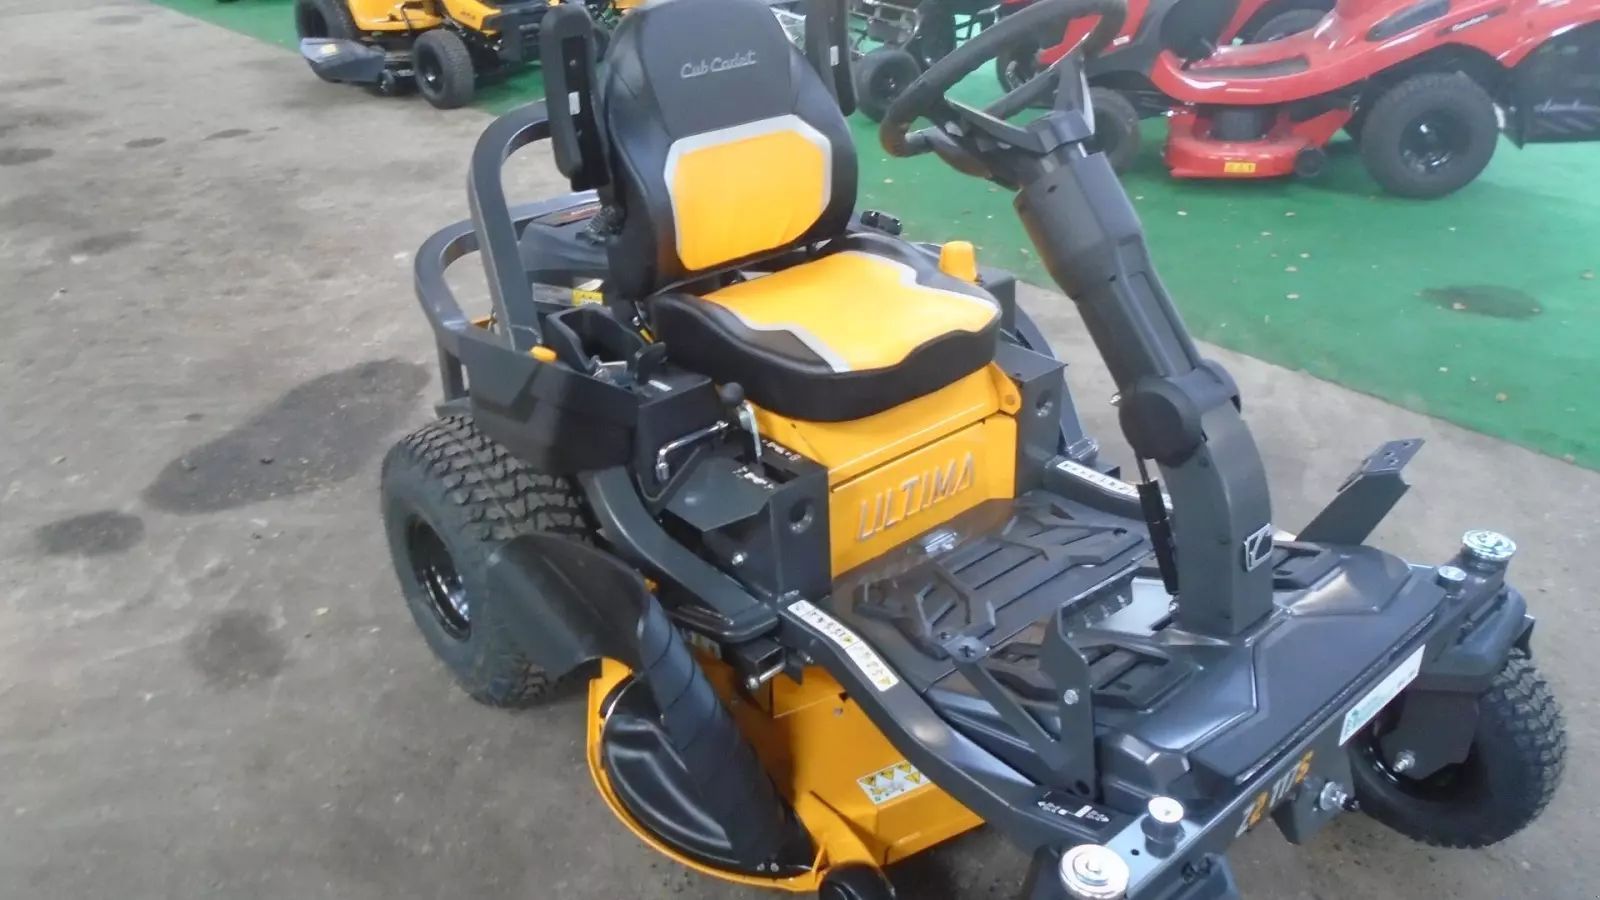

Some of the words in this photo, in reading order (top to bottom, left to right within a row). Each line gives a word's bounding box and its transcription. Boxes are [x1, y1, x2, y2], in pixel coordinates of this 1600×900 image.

[681, 60, 708, 78] Cub
[711, 51, 757, 72] Cadet
[858, 453, 974, 540] ULTIMA
